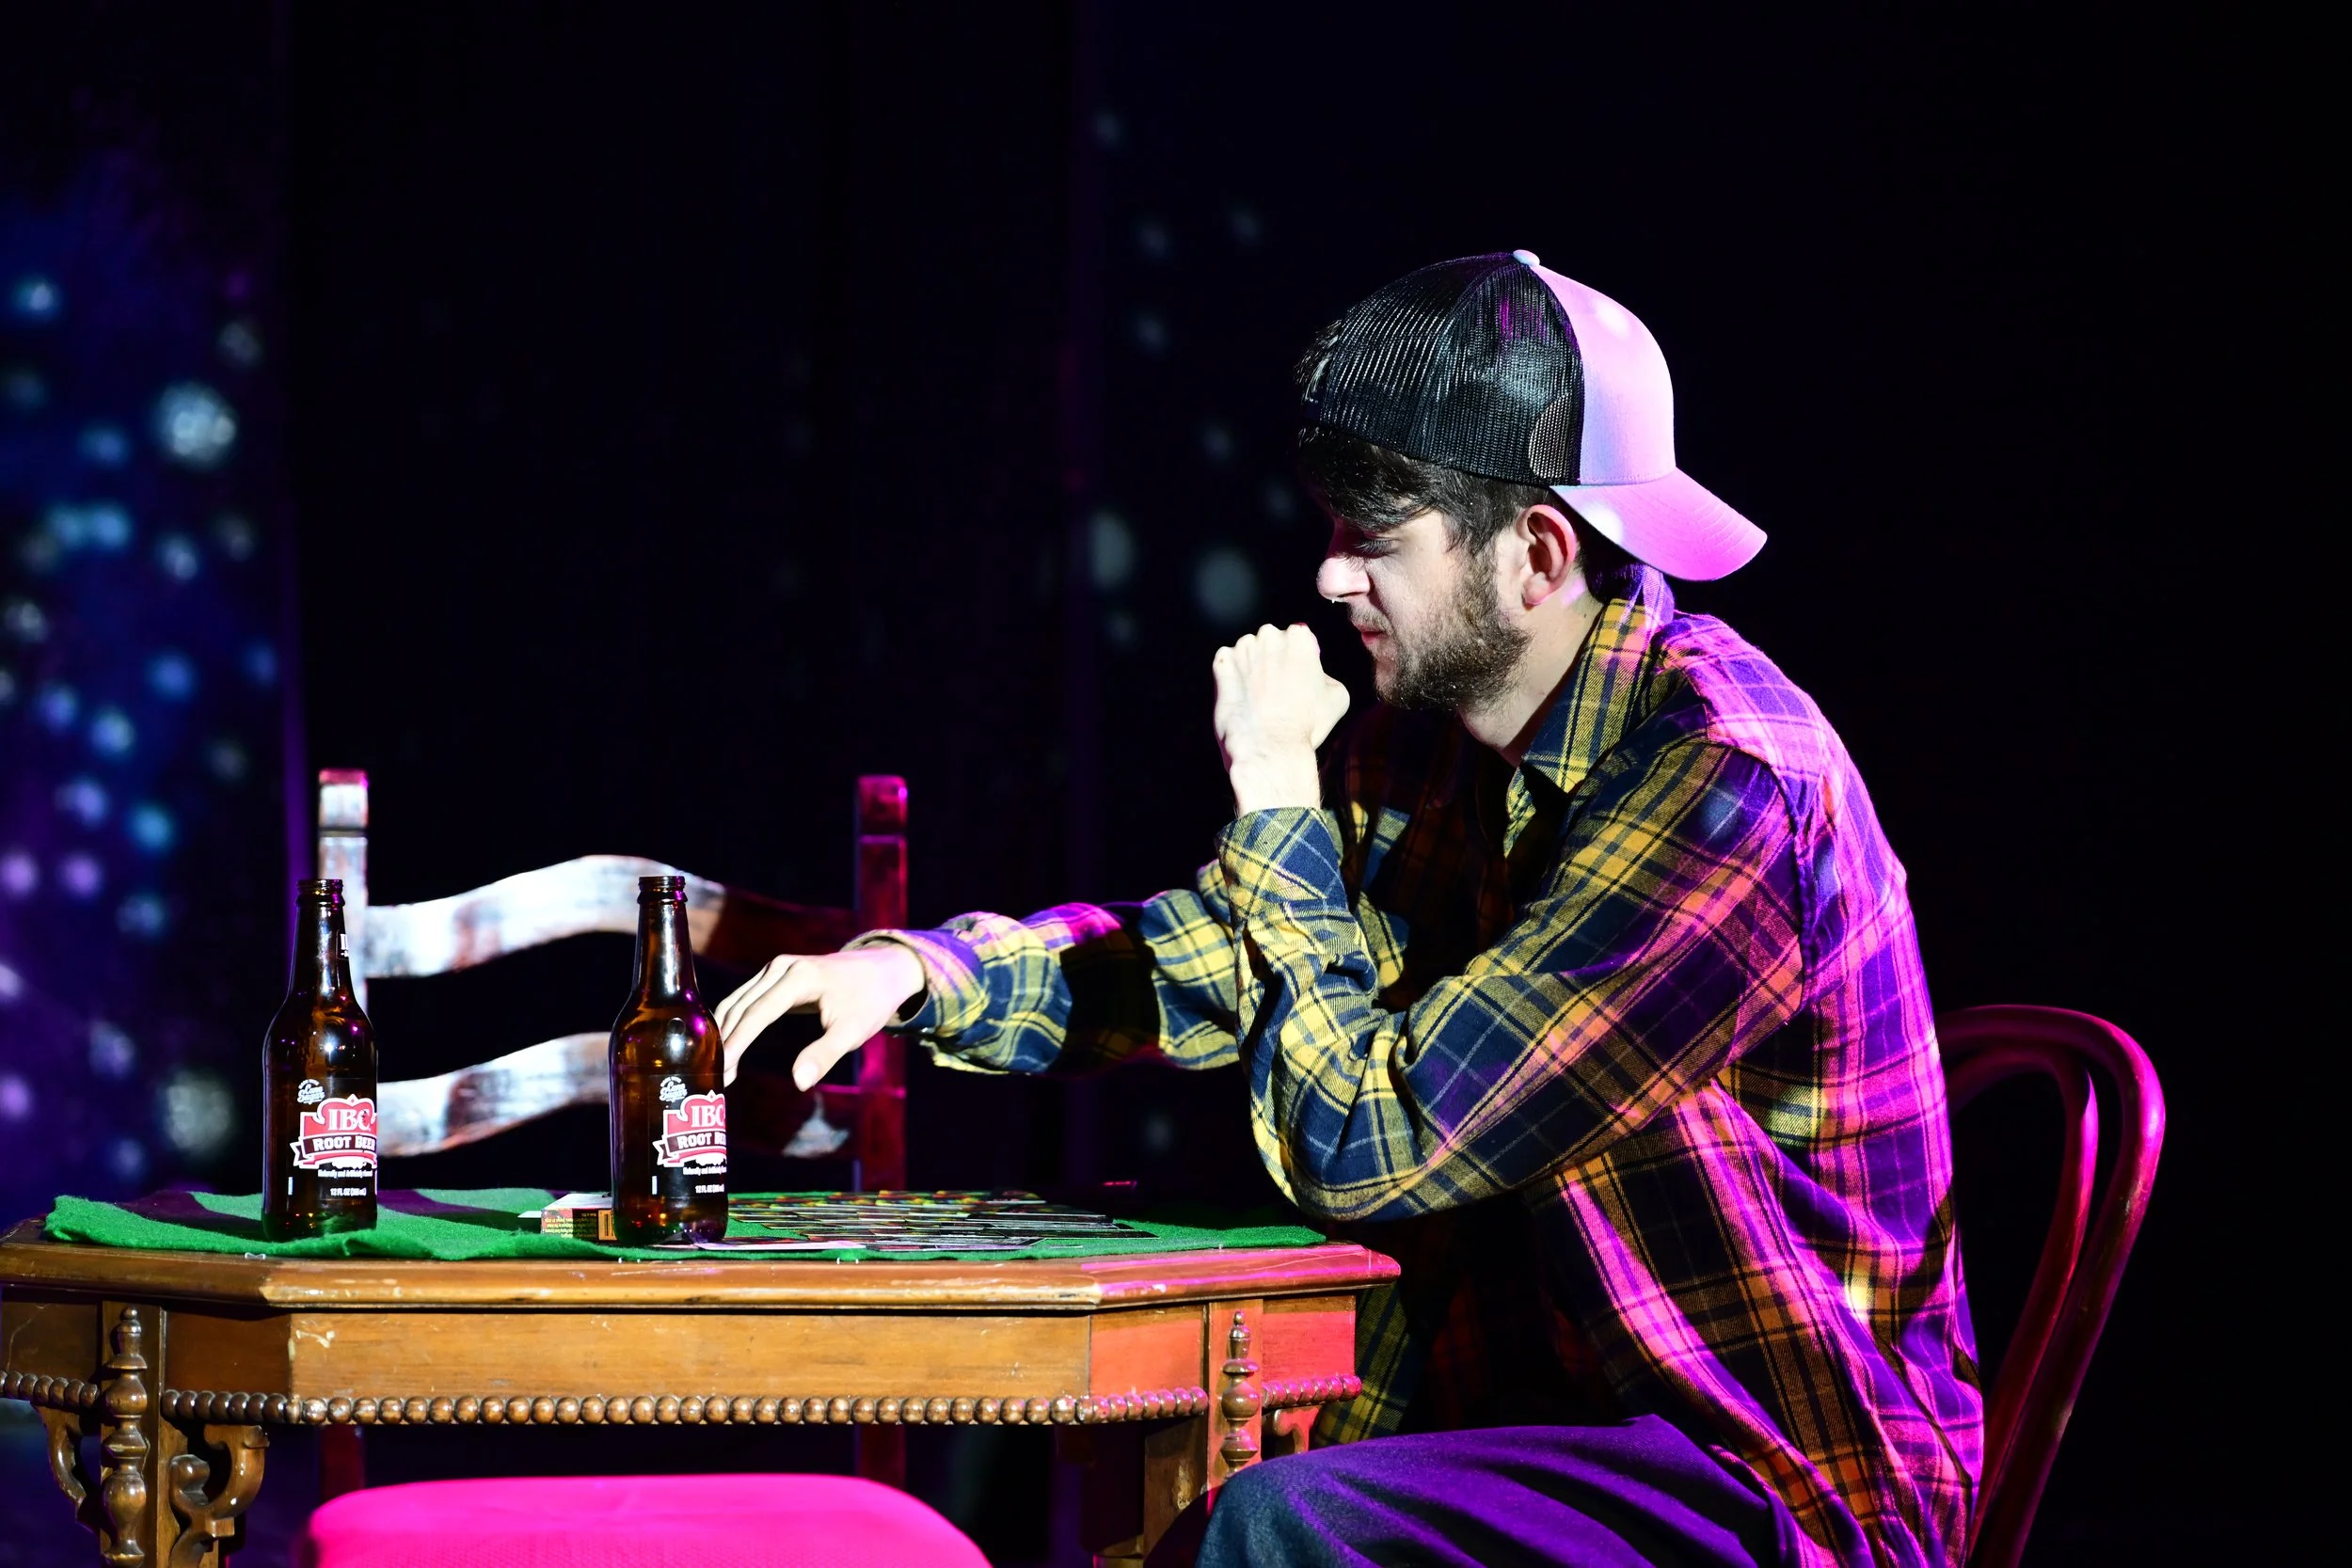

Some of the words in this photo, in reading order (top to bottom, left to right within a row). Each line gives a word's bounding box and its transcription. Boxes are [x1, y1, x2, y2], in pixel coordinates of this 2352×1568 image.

[327, 1108, 371, 1132] IBC
[691, 1105, 724, 1128] IBC
[312, 1136, 352, 1151] ROOT
[677, 1132, 712, 1148] ROOT
